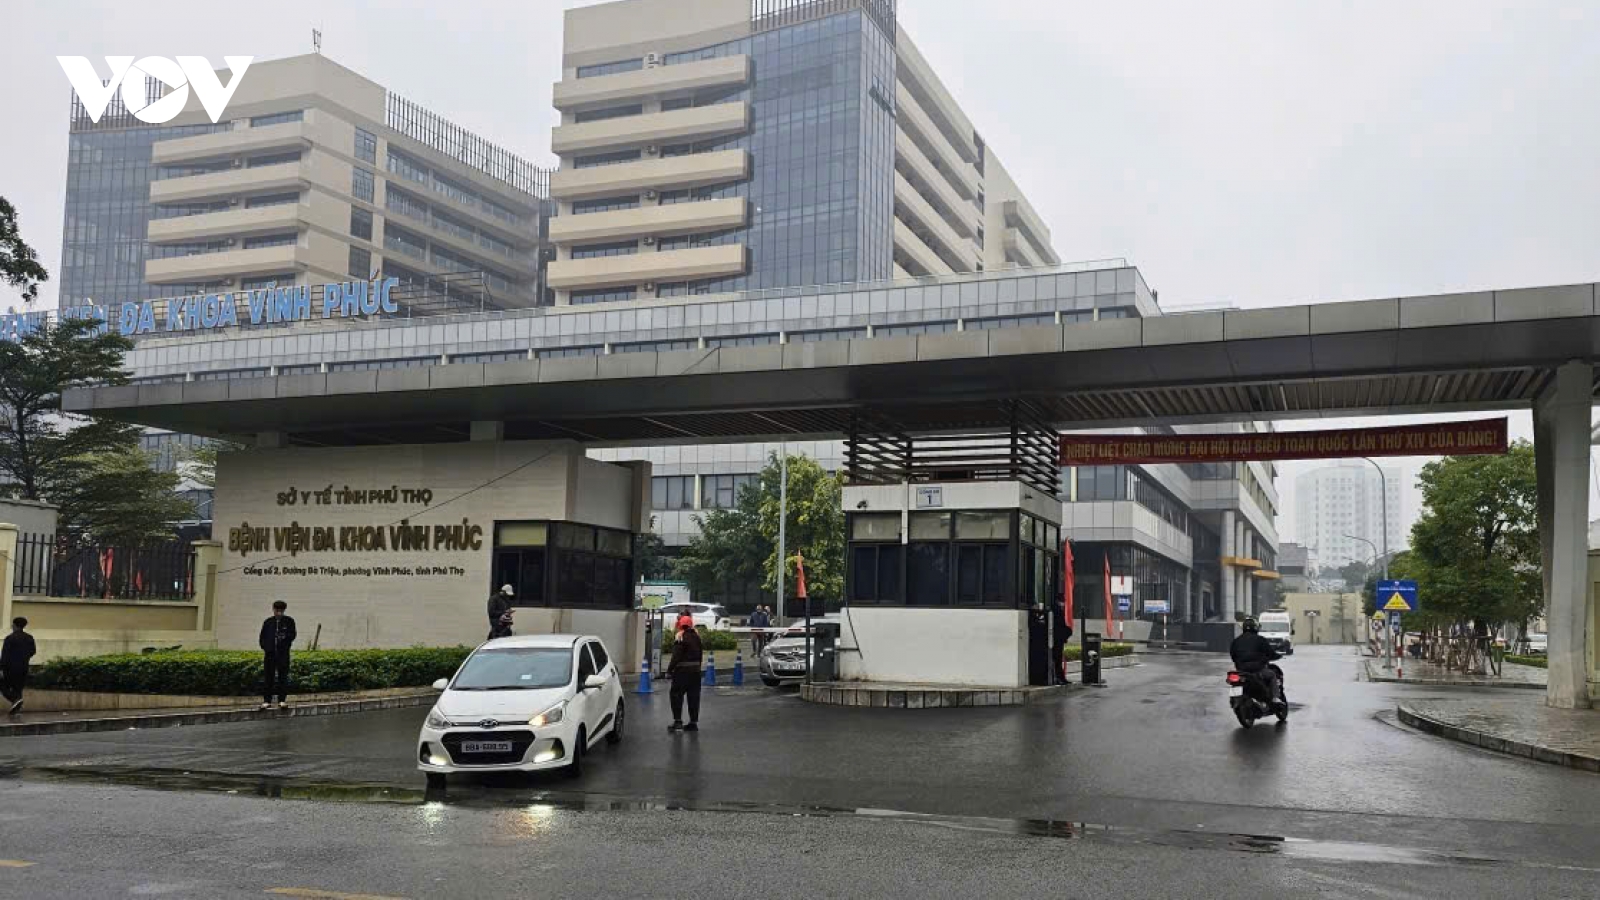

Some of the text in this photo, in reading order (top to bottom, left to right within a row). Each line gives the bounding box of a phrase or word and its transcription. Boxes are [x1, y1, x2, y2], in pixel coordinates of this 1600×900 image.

[0, 305, 43, 344] ỆNH
[119, 301, 156, 336] ĐA
[166, 292, 238, 332] KHOA
[247, 281, 311, 325] VĨNH
[322, 269, 399, 319] PHÚC
[1405, 432, 1426, 448] XIV
[1429, 428, 1454, 447] CỦA
[277, 484, 433, 506] SỞ Y TẾ TỈNH PHÚ THỌ
[927, 495, 932, 504] 1
[228, 517, 483, 557] BỆNH VIỆN ĐA KHOA VĨNH PHÚC
